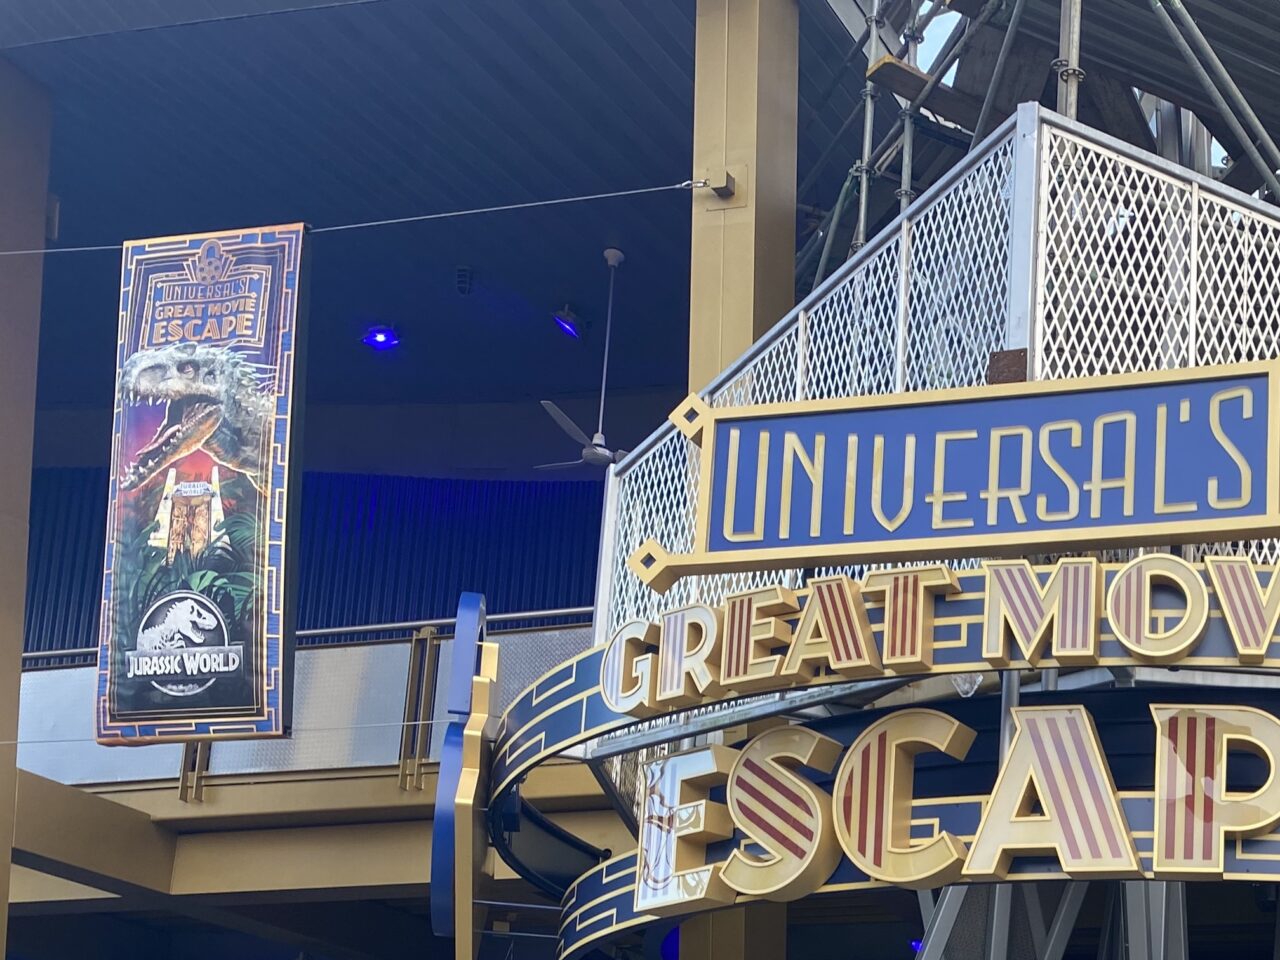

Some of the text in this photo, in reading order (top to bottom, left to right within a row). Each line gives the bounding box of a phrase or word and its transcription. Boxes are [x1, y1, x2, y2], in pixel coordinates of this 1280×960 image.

[164, 279, 246, 301] UNIVERSAL'S
[155, 298, 257, 320] GREAT MOVIE
[152, 313, 254, 344] ESCAPE
[719, 385, 1255, 543] UNIVERSAL'S
[600, 563, 961, 719] GREAT
[127, 652, 240, 678] JURASSIC WORLD
